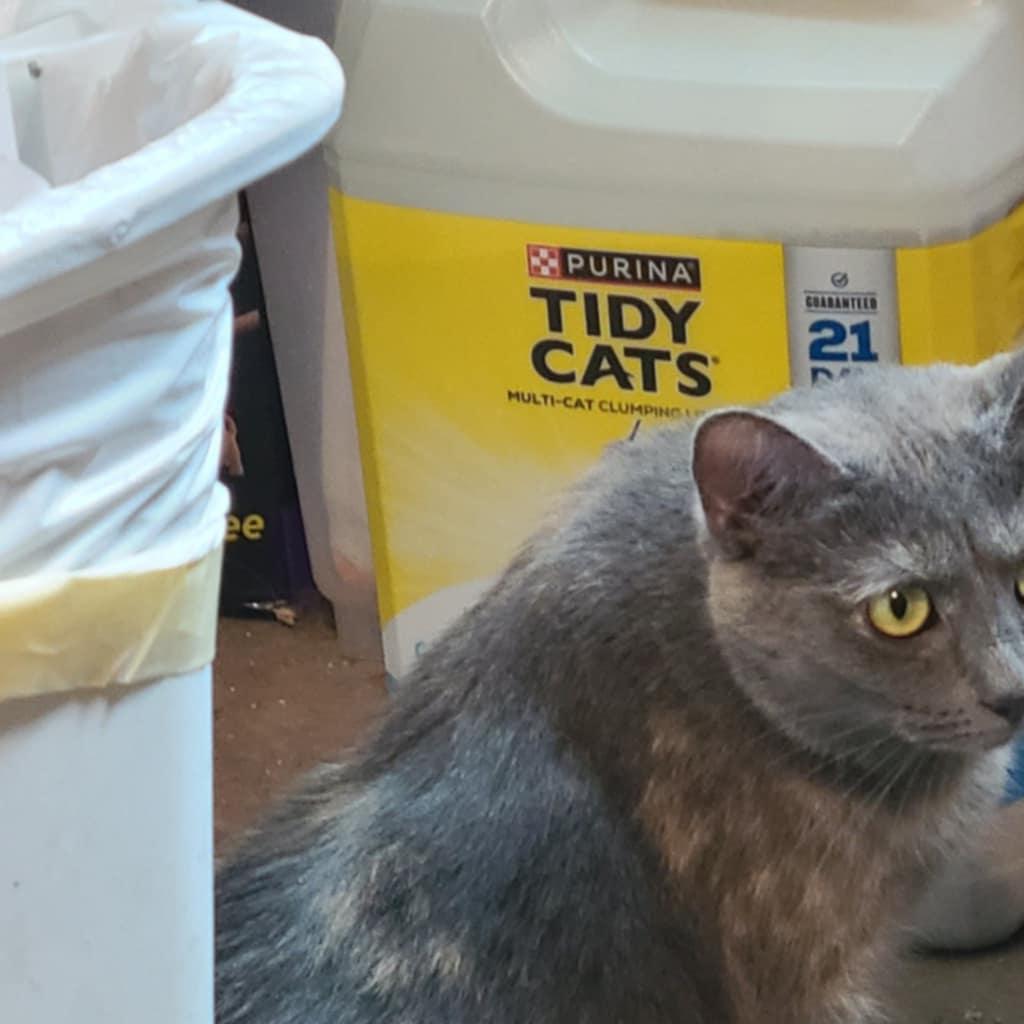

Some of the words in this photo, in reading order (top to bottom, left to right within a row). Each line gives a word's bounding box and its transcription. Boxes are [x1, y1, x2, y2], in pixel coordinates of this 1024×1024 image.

[566, 252, 693, 283] PURINA
[529, 286, 700, 345] TIDY
[808, 319, 879, 362] 21
[530, 339, 713, 398] CATS
[507, 389, 594, 412] MULTI-CAT
